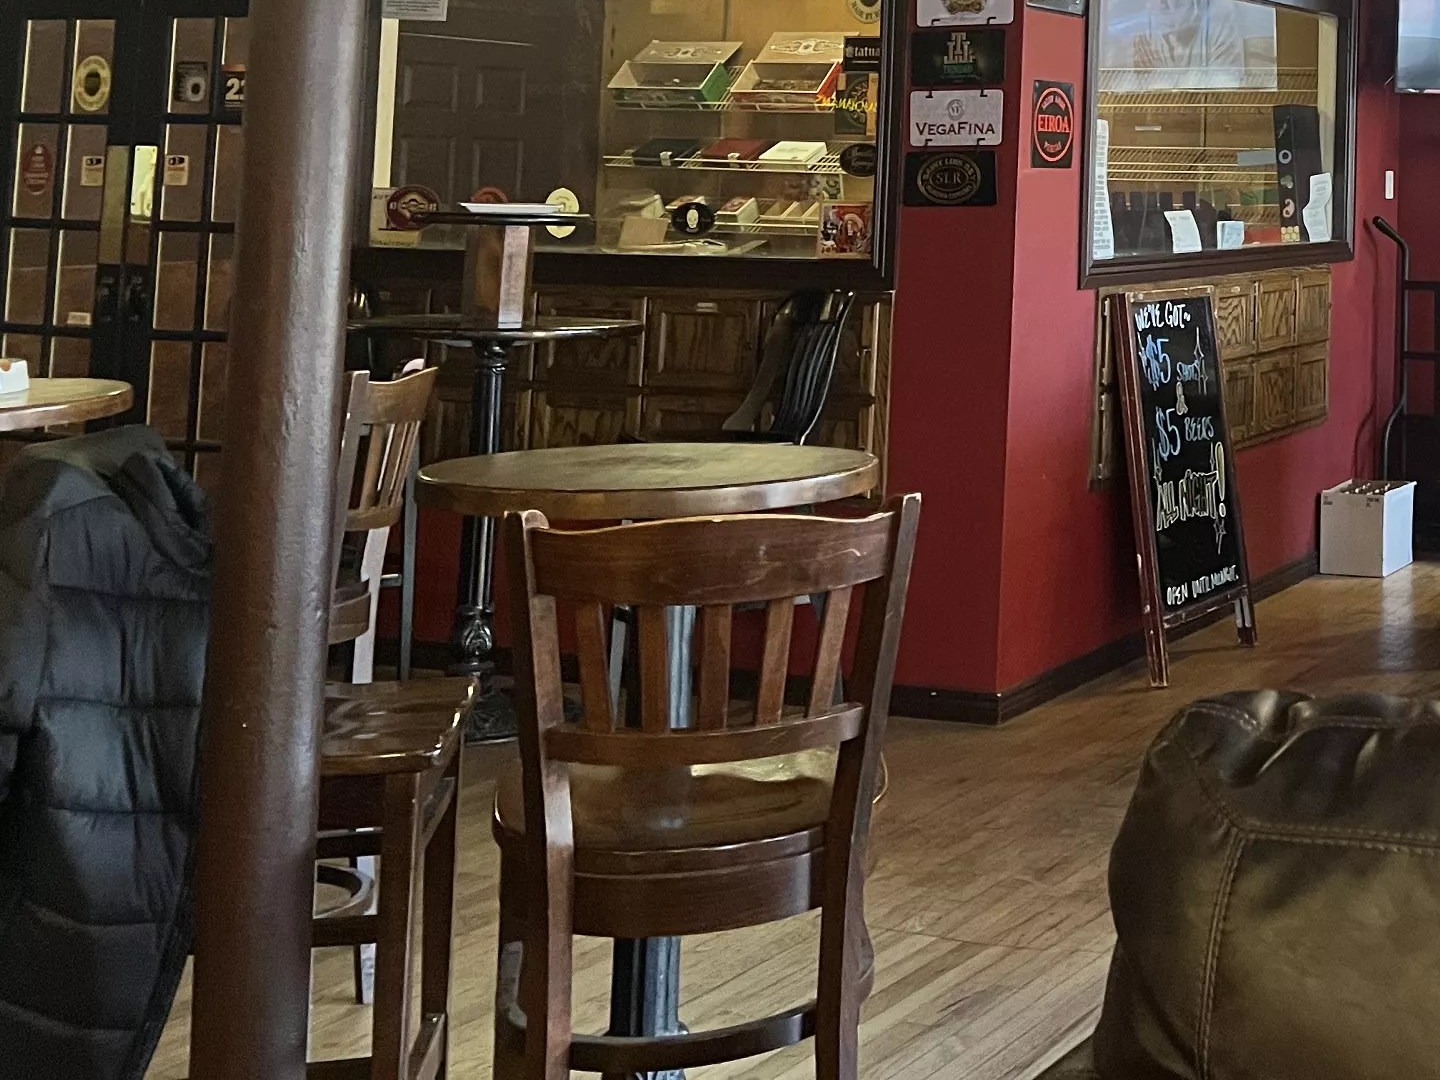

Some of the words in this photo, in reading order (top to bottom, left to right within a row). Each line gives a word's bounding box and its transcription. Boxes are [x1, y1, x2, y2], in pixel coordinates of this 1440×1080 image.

[1037, 114, 1071, 133] EIROA
[1145, 334, 1172, 391] $5
[1155, 406, 1181, 461] $5
[1184, 416, 1215, 442] BEERS
[1166, 582, 1188, 605] OPEN
